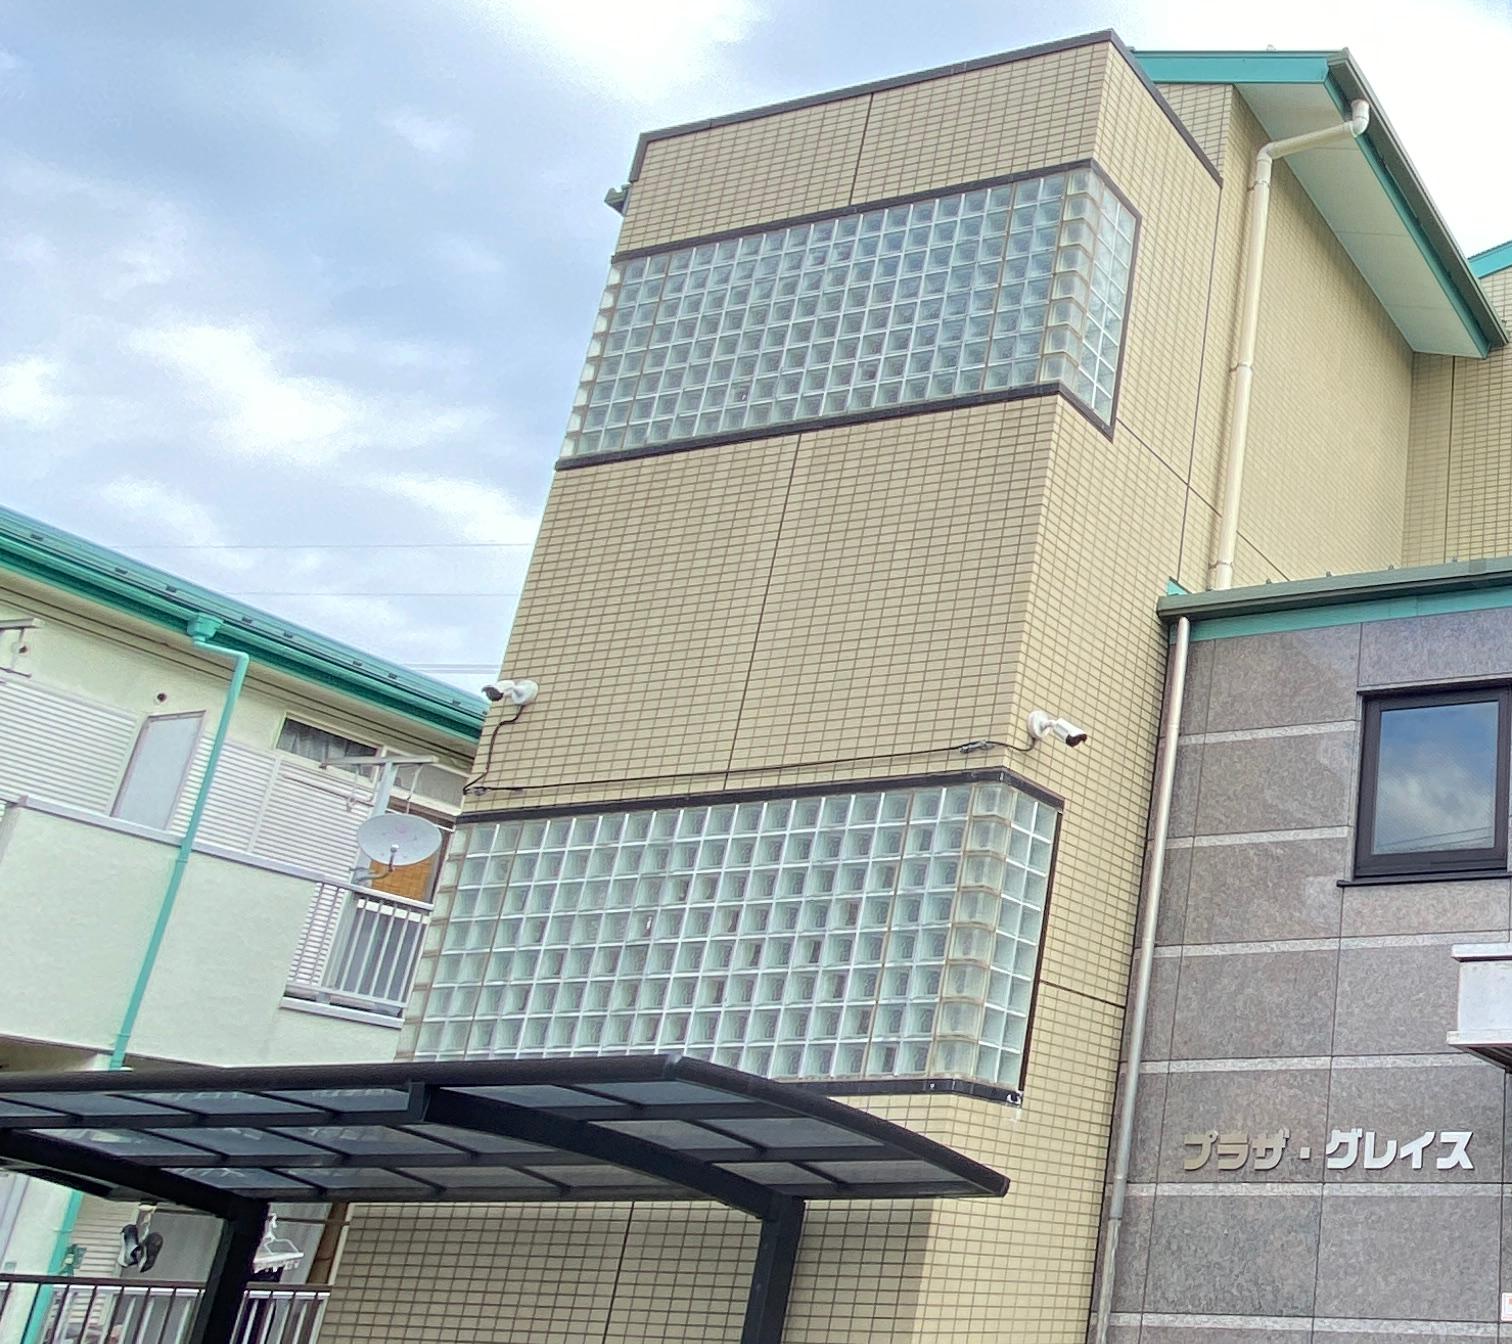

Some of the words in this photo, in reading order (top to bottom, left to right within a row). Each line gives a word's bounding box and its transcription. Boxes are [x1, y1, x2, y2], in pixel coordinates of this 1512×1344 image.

[1184, 1128, 1474, 1170] プラザ・グレイス
